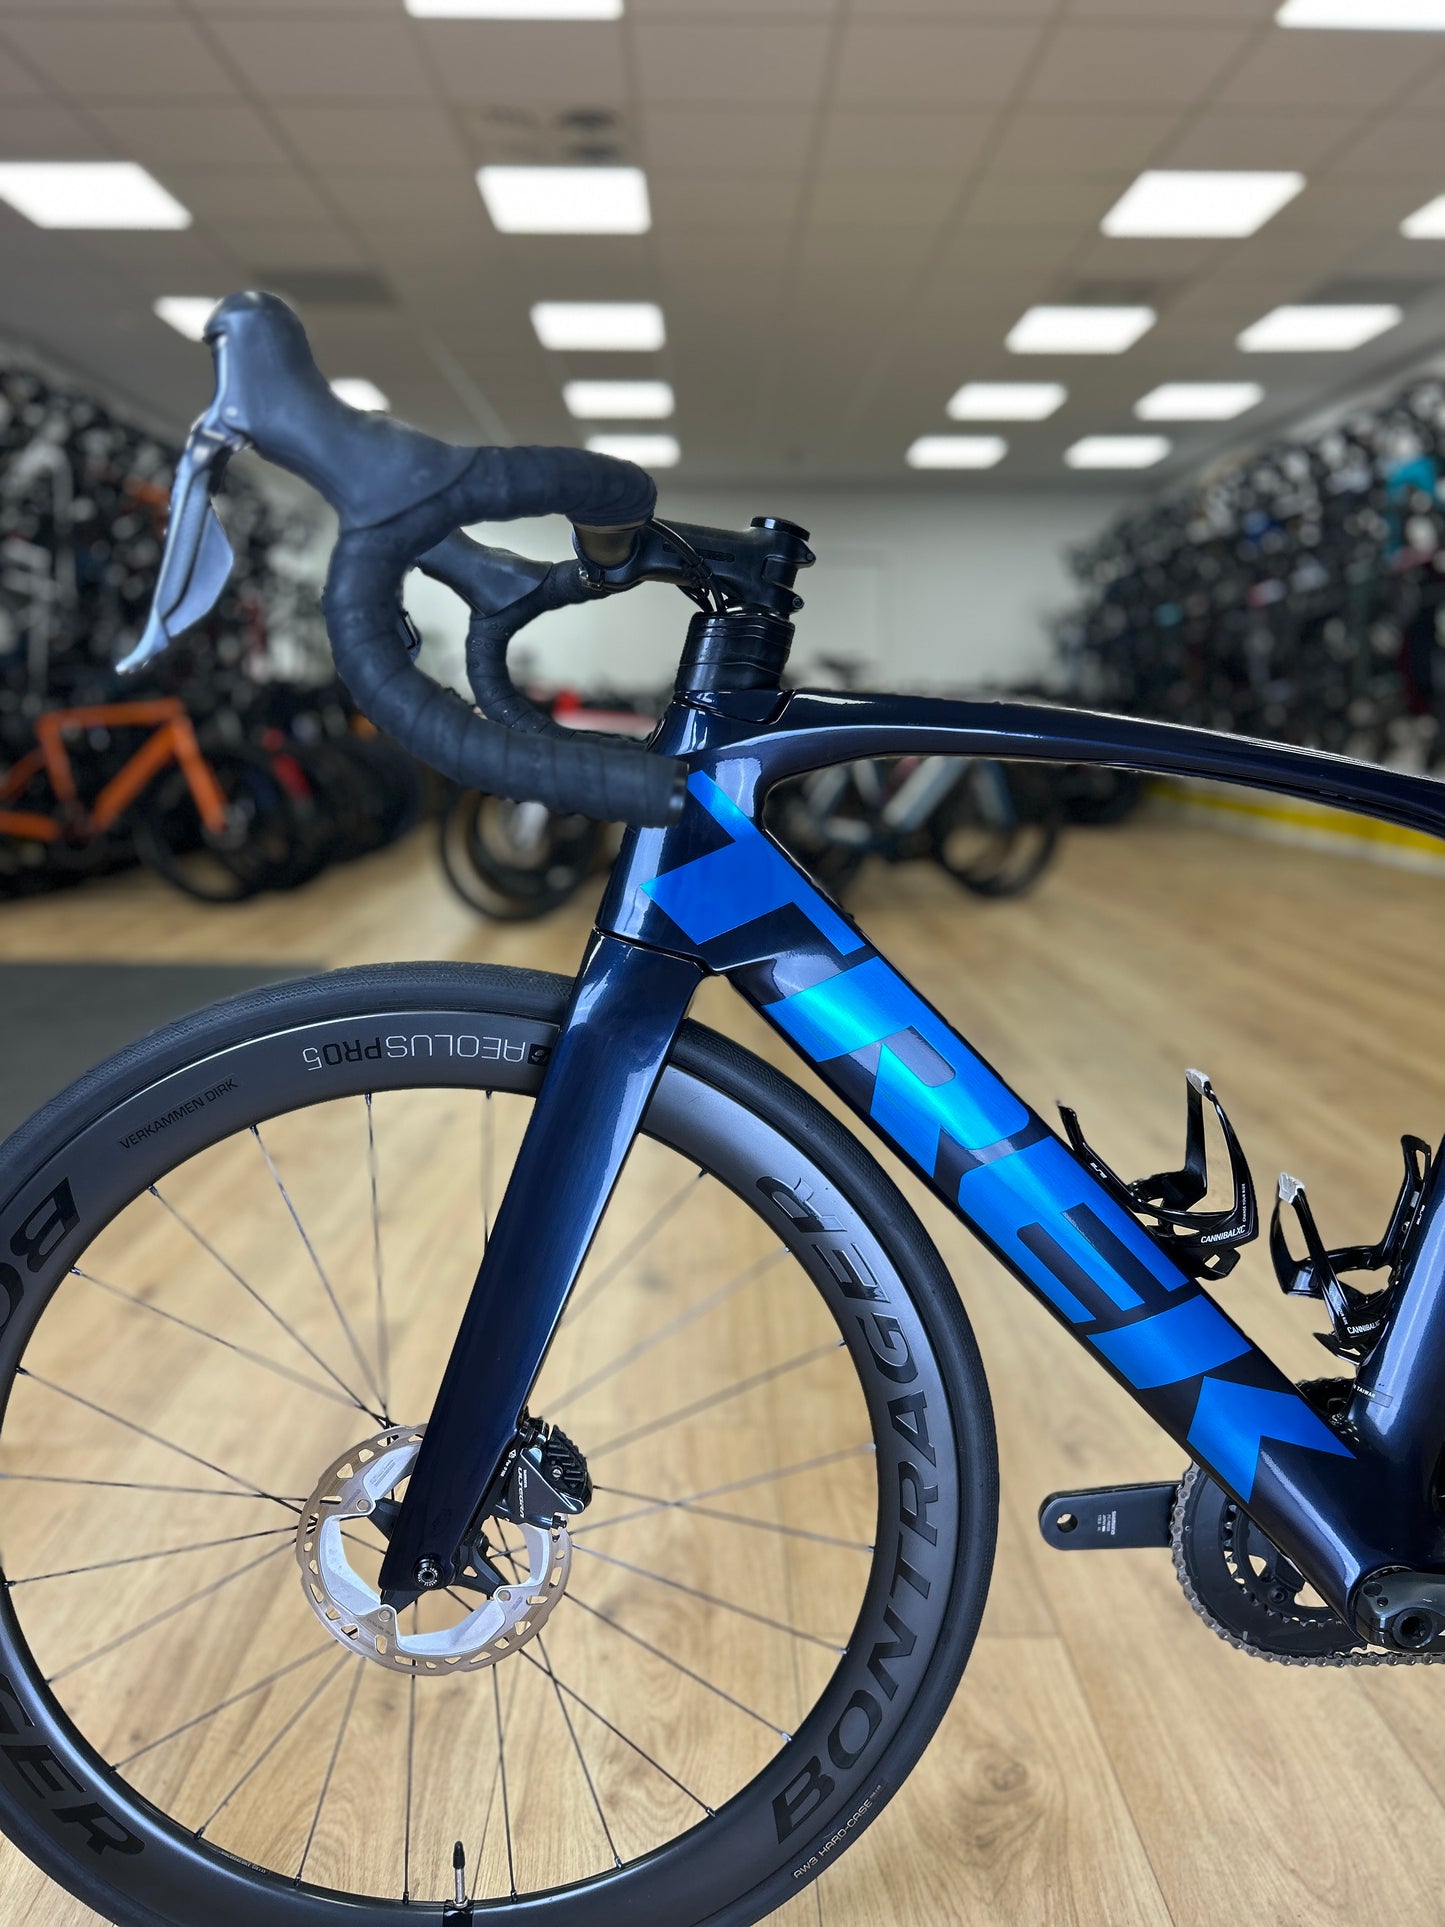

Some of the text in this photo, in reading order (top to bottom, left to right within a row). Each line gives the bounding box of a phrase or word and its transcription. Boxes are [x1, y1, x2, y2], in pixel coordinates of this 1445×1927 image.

[120, 1078, 239, 1149] VERKAMMEN DIRK
[640, 770, 1356, 1503] TREK
[756, 1176, 941, 1845] BONTRAGER
[793, 1799, 872, 1879] AW3 HARD-CASE
